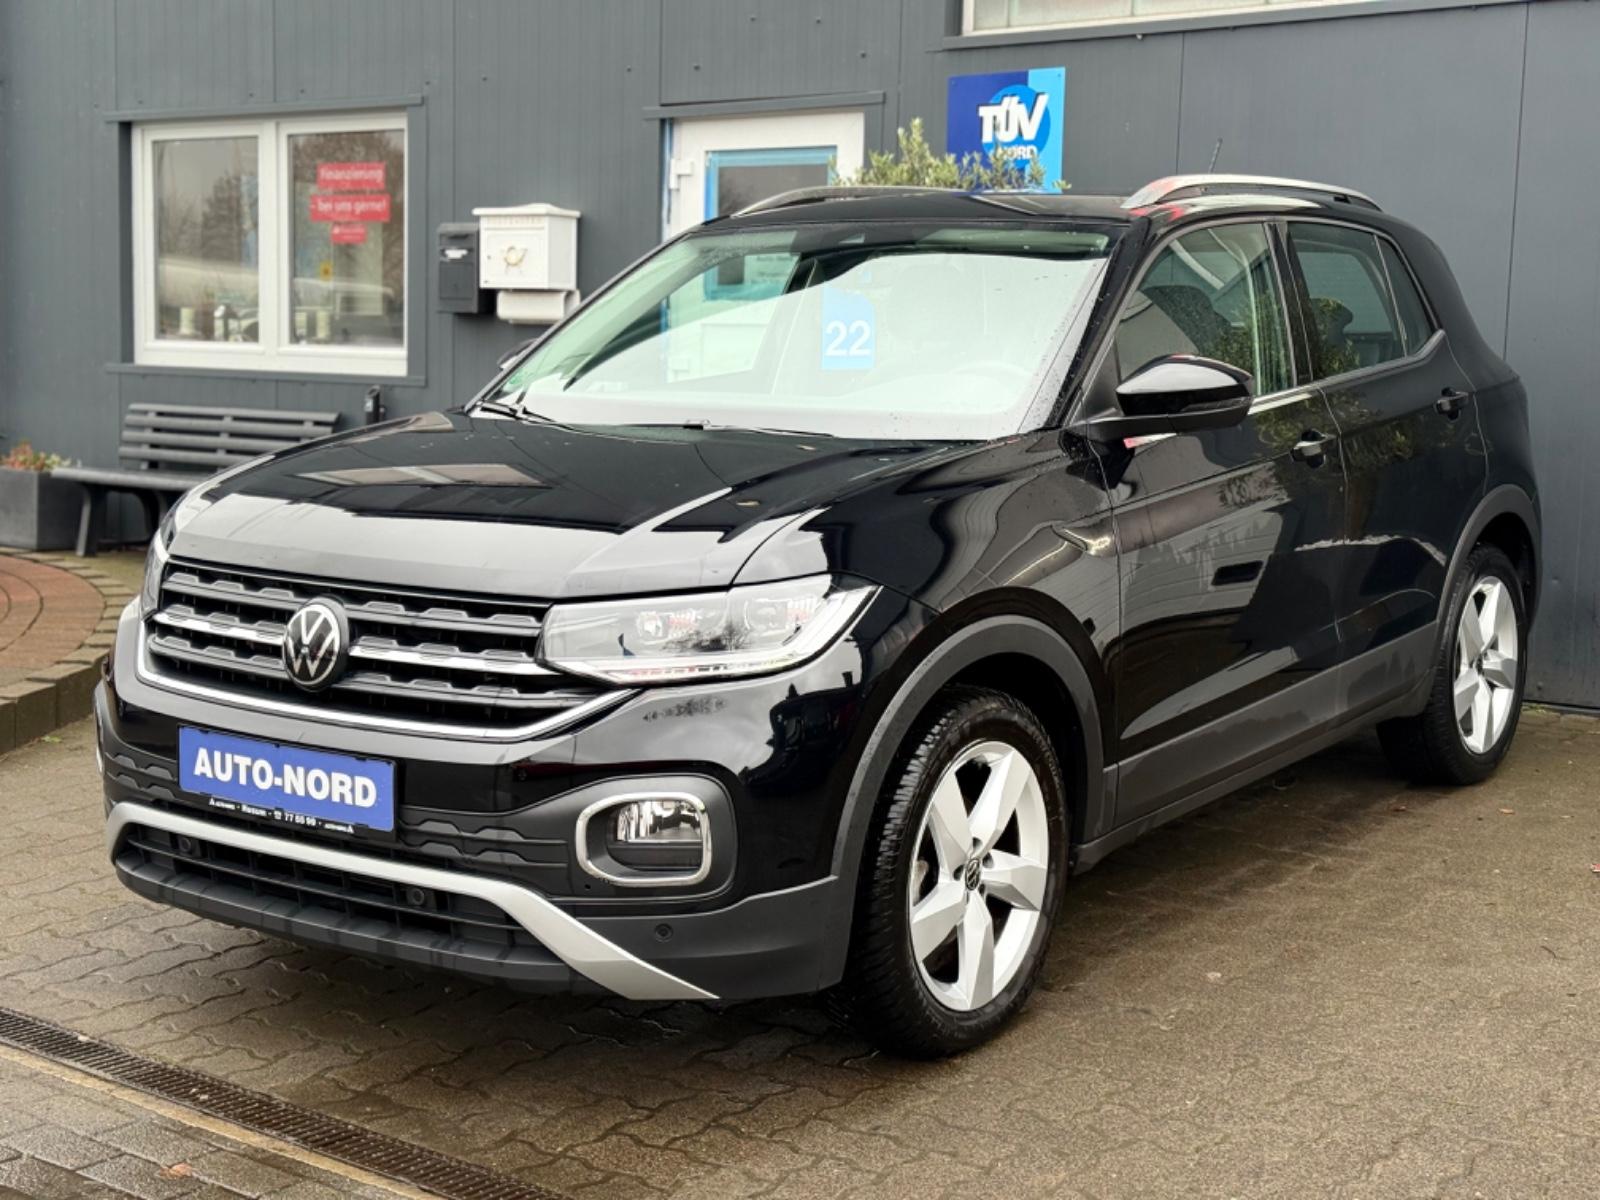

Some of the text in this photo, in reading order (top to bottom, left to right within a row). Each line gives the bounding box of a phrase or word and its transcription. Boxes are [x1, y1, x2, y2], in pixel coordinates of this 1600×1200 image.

[978, 93, 1049, 143] TÜV
[825, 319, 871, 356] 22
[193, 747, 377, 808] AUTO-NORD
